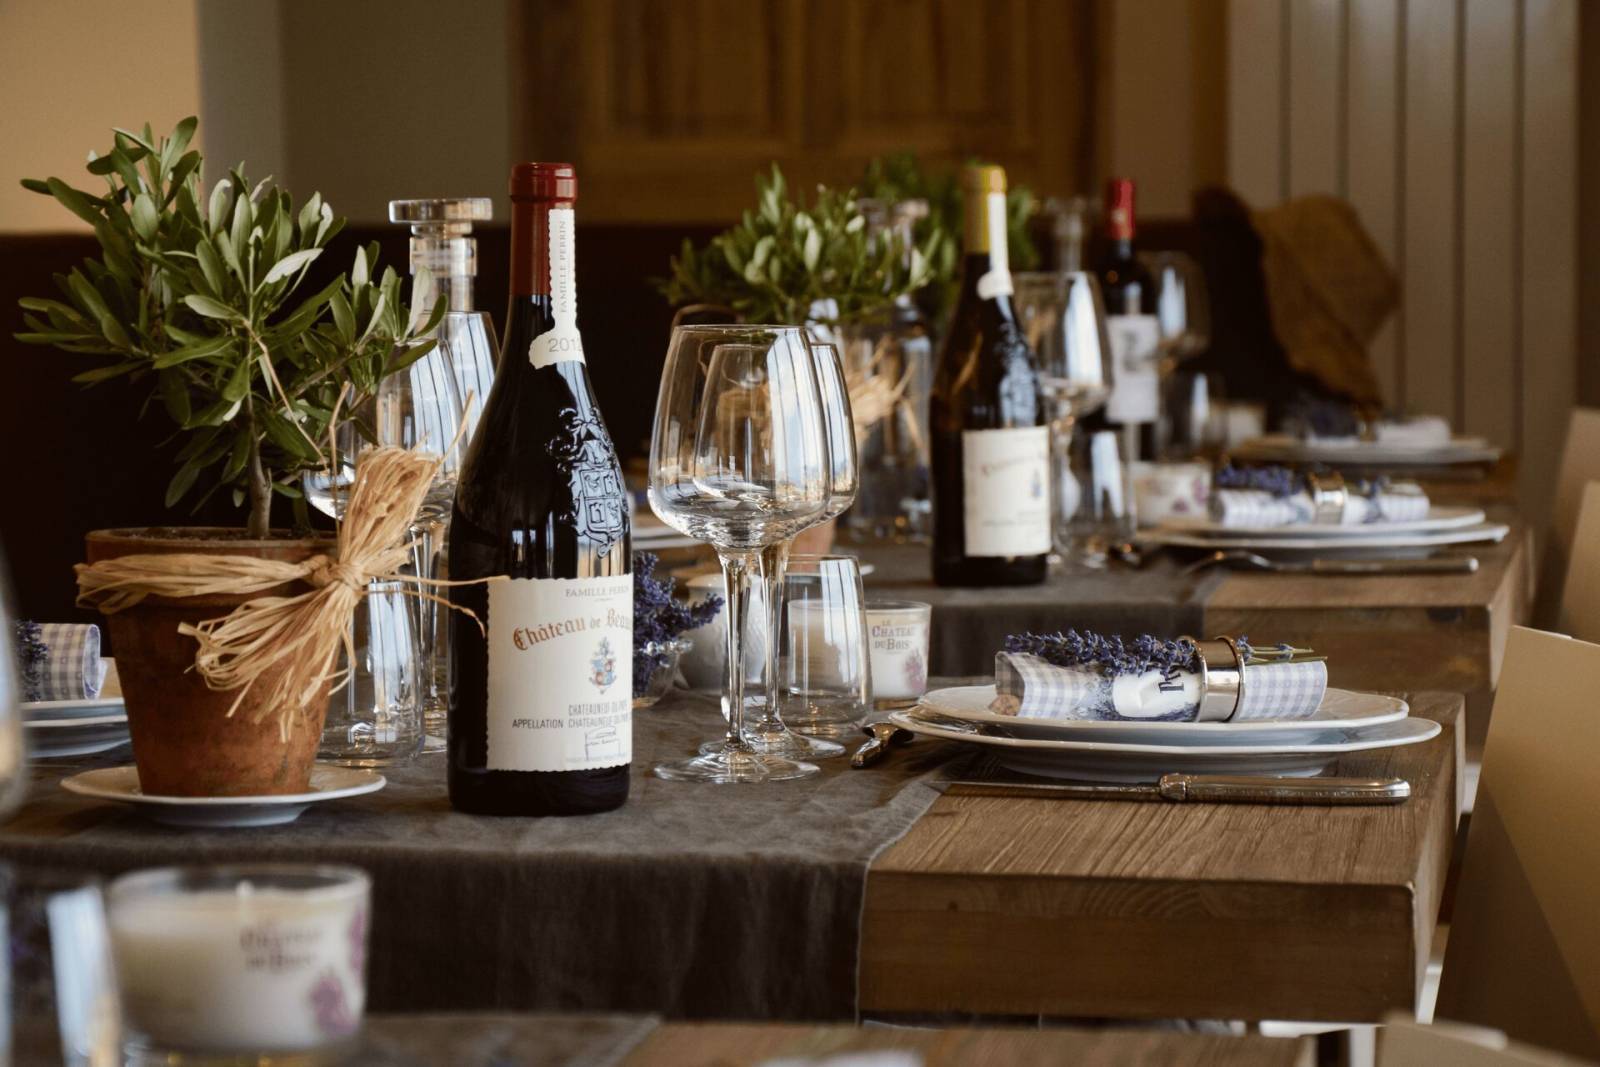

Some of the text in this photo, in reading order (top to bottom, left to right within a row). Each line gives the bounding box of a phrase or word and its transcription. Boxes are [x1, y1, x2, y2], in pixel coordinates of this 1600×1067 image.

[559, 220, 567, 313] FAMILLE PERRIN
[511, 719, 564, 729] APPELLATION
